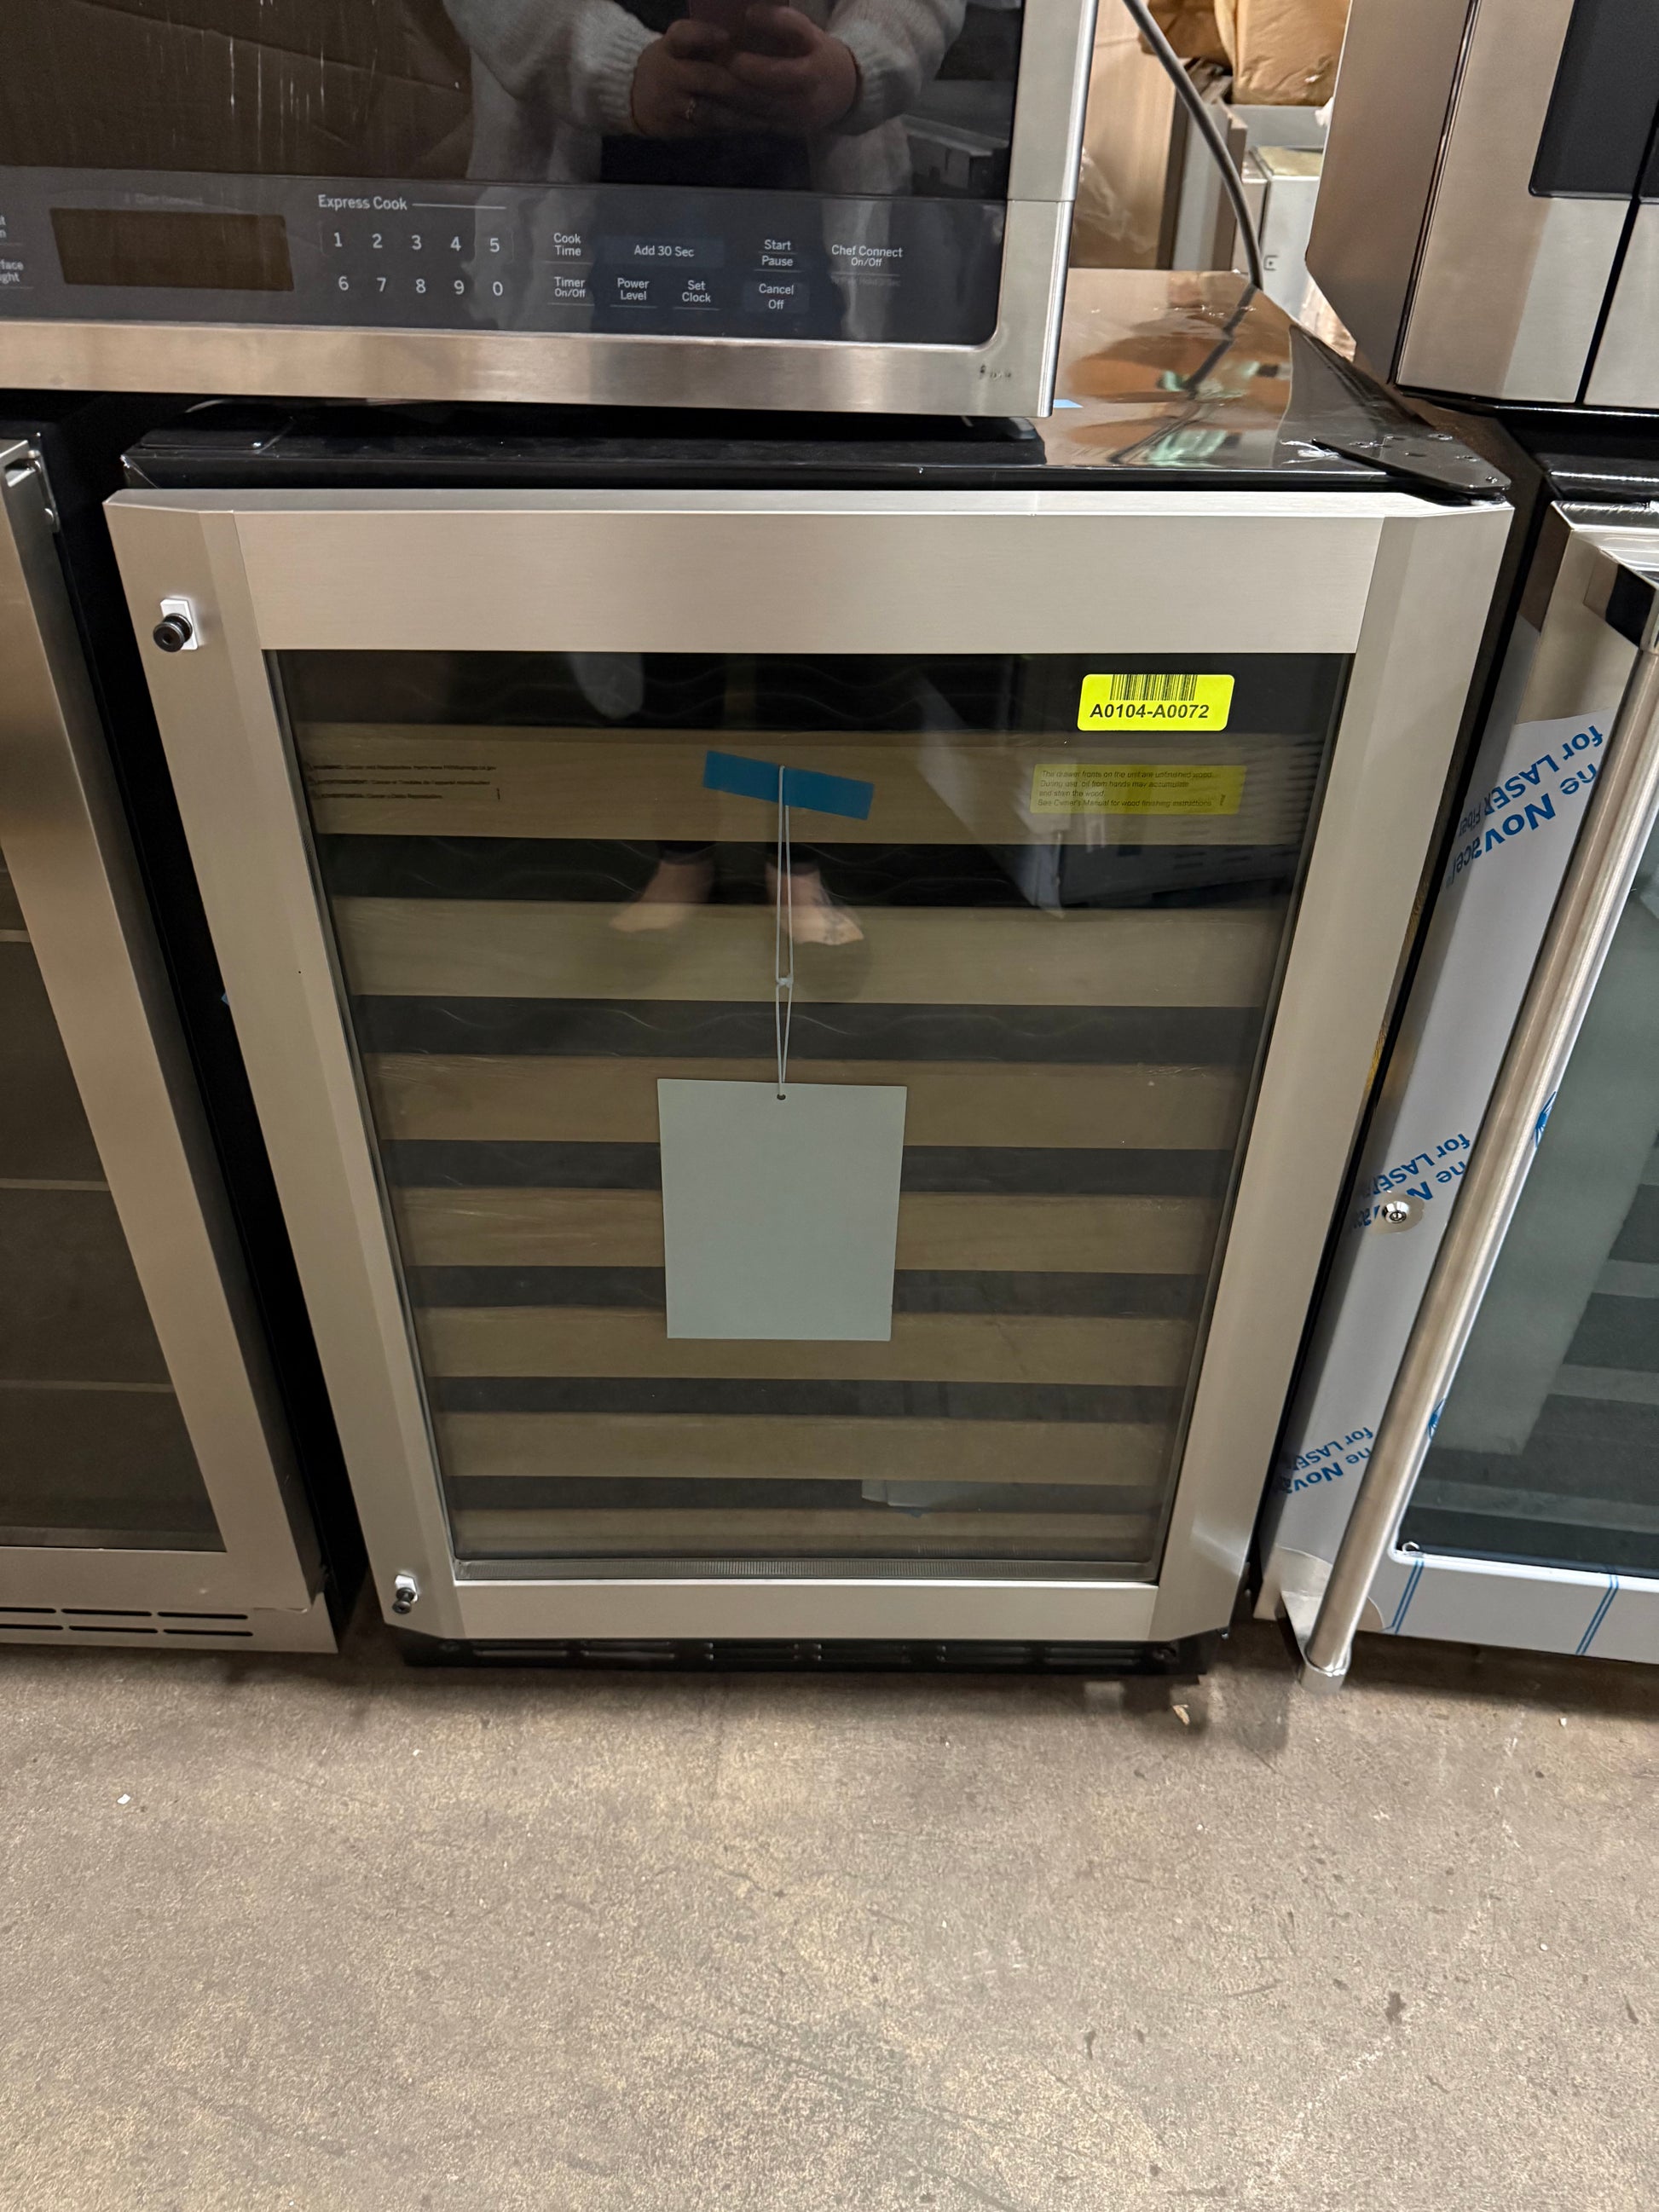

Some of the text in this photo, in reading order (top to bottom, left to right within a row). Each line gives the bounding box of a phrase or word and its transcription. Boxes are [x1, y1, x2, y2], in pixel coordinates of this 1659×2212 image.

[318, 194, 408, 211] Express Cook
[333, 232, 500, 252] 1 2 3 4 5
[553, 232, 581, 244] Cook
[554, 245, 581, 257] Time
[633, 245, 695, 257] Add 30 Sec
[764, 239, 791, 251] Start
[831, 245, 904, 257] Chef Connect
[761, 256, 794, 267] Pause
[851, 257, 882, 267] On/Off
[338, 276, 503, 296] 6 7 8 9 0
[554, 276, 586, 288] Timer
[617, 277, 650, 290] Power
[687, 280, 706, 291] Set
[554, 288, 586, 298] On/Off
[759, 283, 795, 295] Cancel
[620, 290, 647, 301] Level
[682, 292, 711, 303] Clock
[768, 299, 784, 310] Off
[1090, 703, 1210, 719] A0104-A0072
[1562, 725, 1604, 760] for
[1436, 1134, 1471, 1158] for
[1345, 1427, 1373, 1446] for
